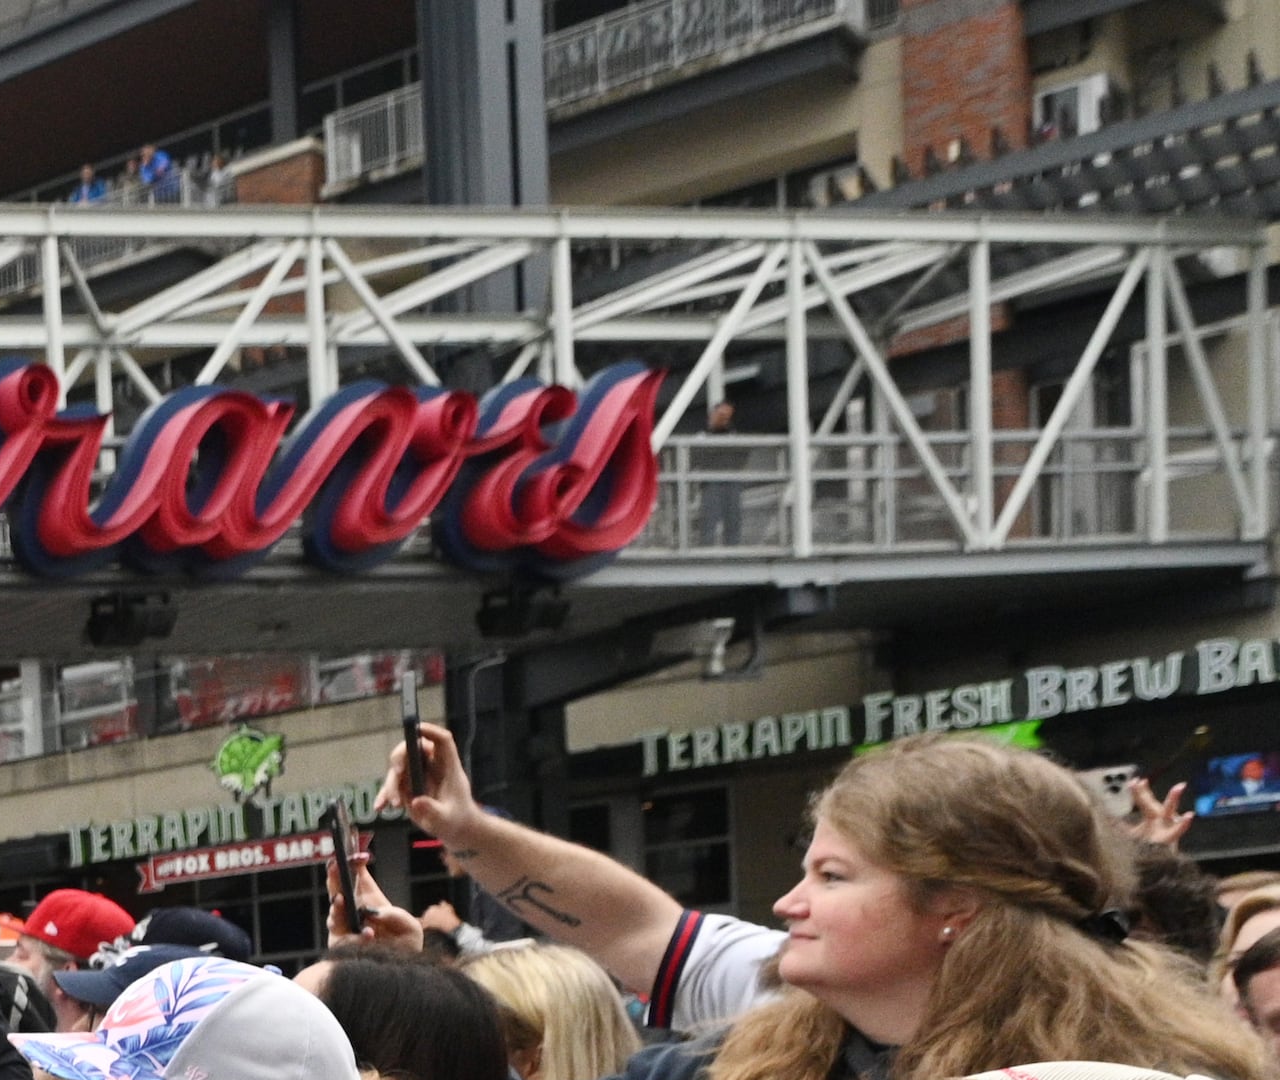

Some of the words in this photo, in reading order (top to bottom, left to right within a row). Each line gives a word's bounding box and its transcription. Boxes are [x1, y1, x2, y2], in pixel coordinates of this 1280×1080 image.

[638, 704, 852, 777] TERRAPIN
[862, 679, 1013, 744] FRESH
[1024, 652, 1185, 720] BREW
[1195, 638, 1280, 695] BA
[67, 802, 246, 868] TERRAPIN
[251, 781, 408, 838] TAPRO
[175, 852, 210, 877] FOX
[214, 844, 271, 871] BROS.
[274, 836, 336, 863] BAR-B
